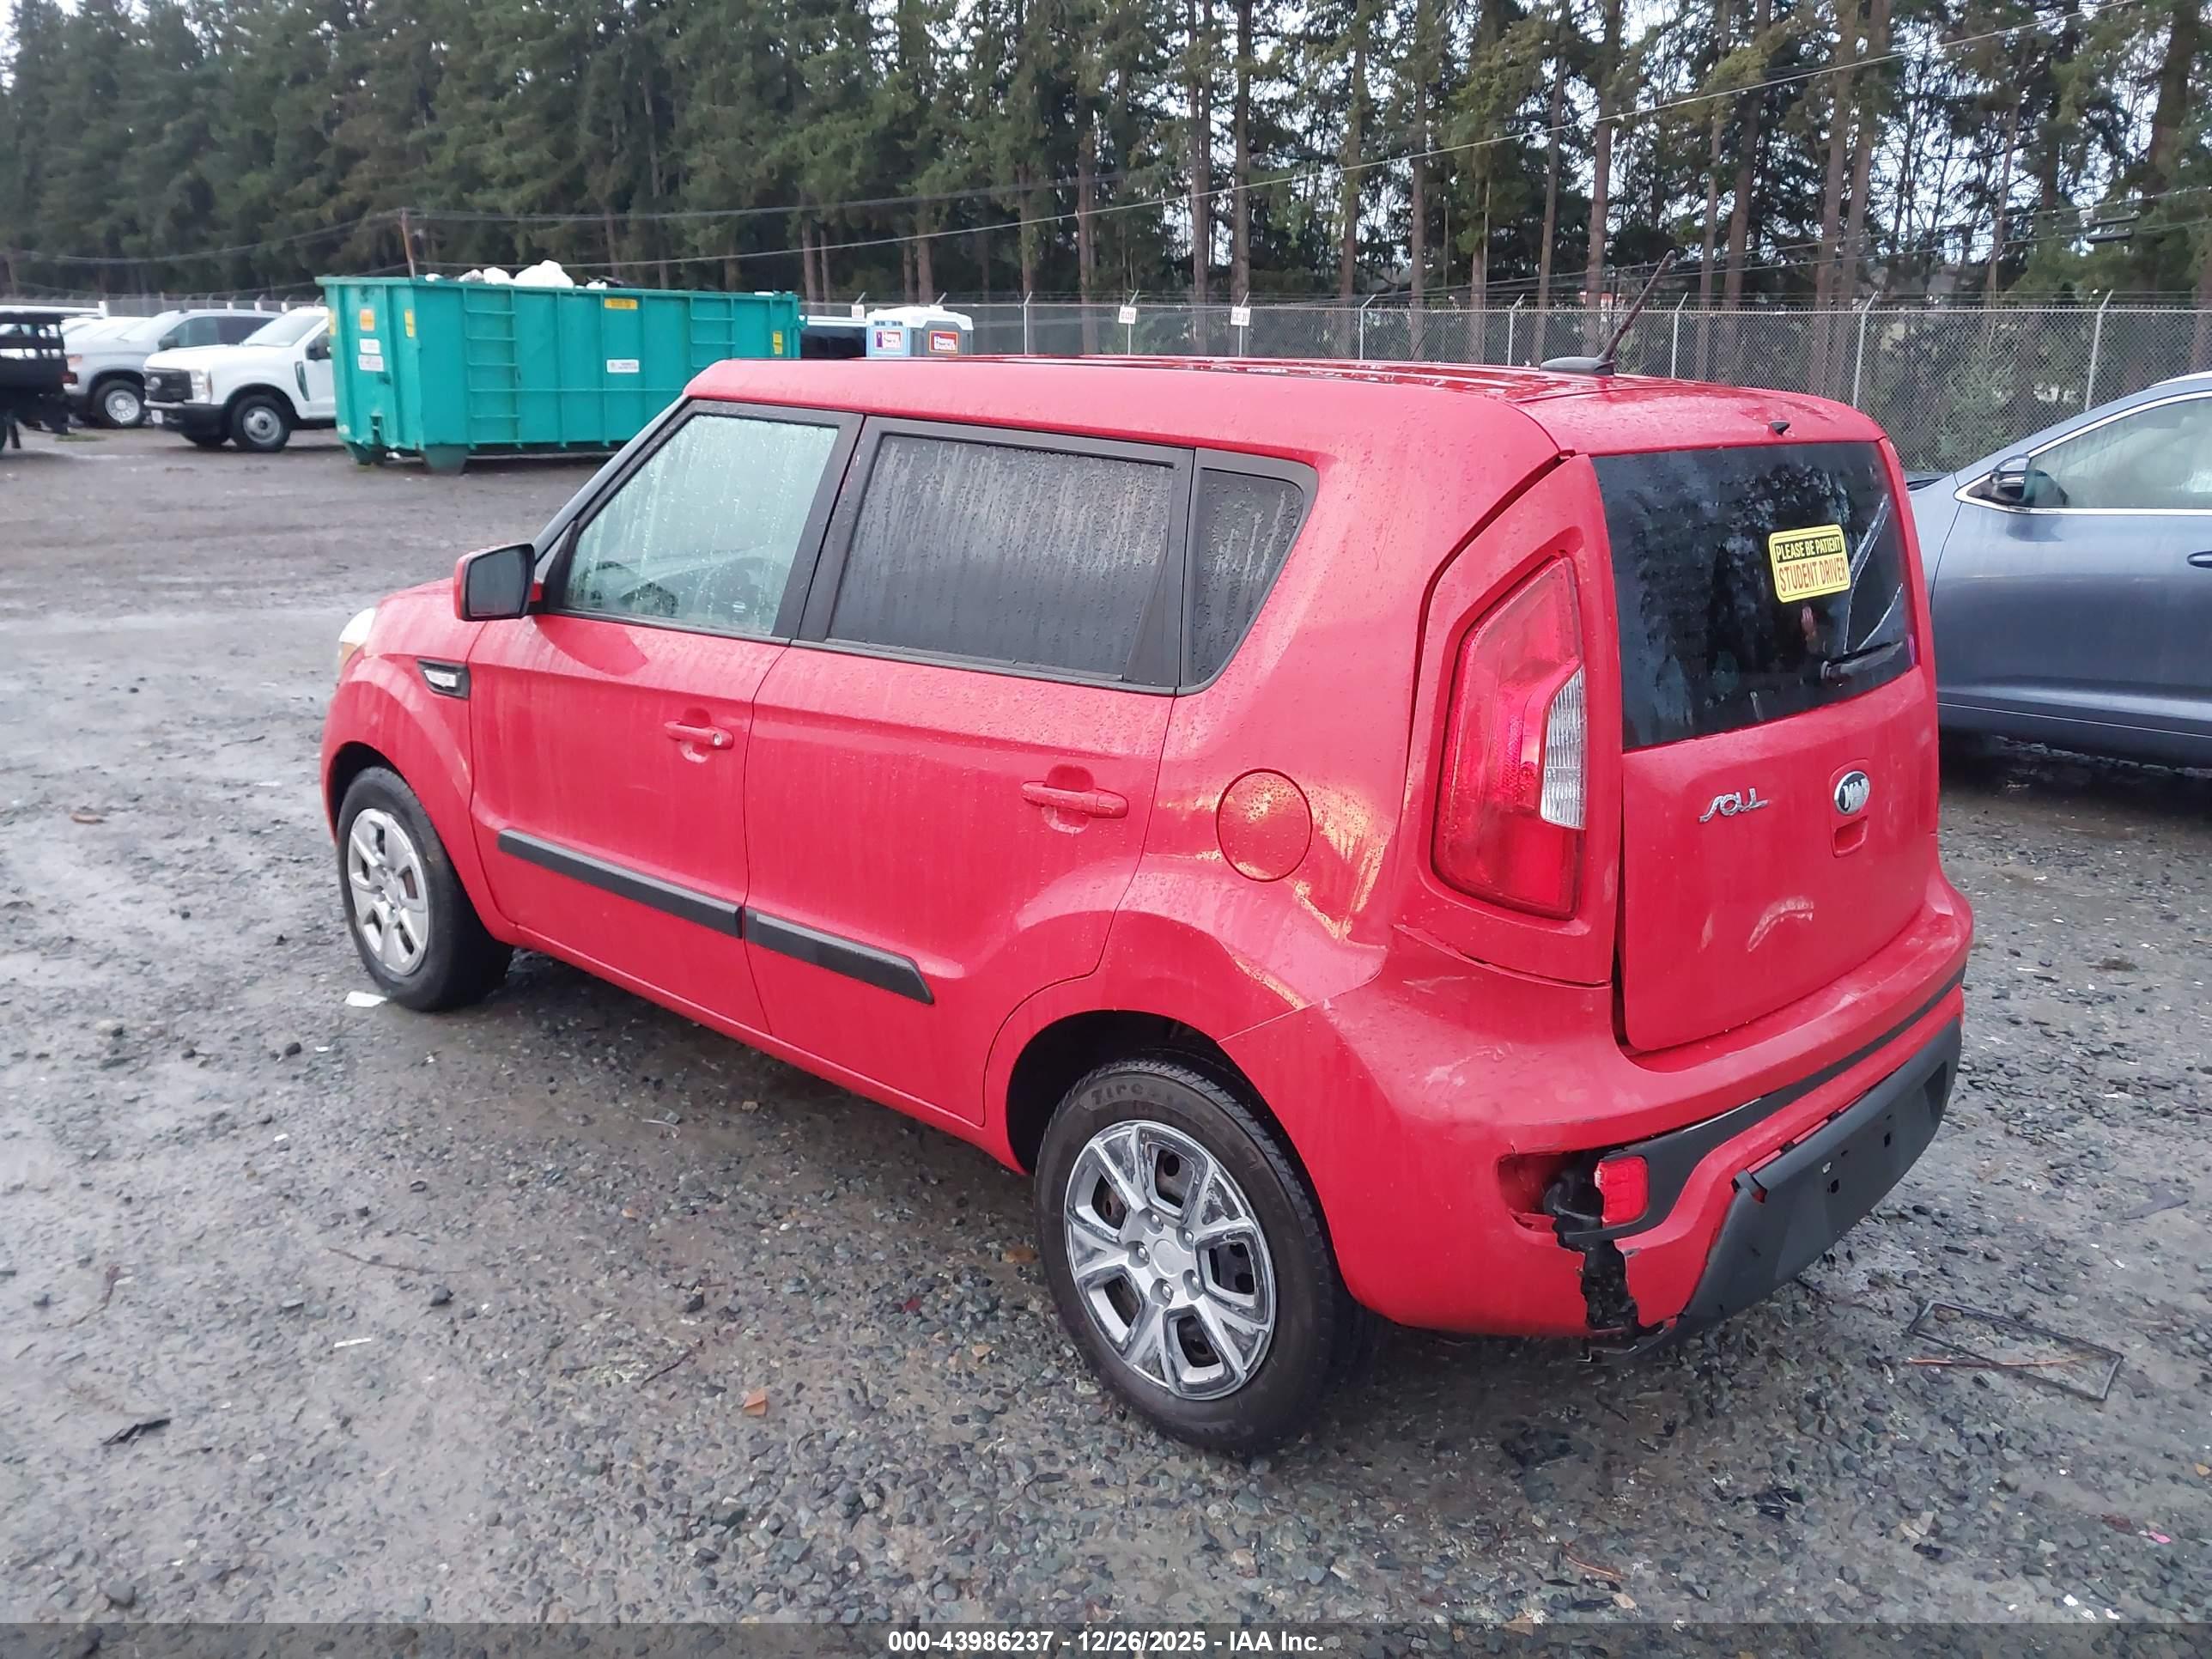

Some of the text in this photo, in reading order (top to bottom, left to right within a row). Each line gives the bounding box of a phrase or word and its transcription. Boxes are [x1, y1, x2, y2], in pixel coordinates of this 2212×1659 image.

[1775, 537, 1841, 561] PLEASE BE PATIENT
[1778, 556, 1847, 592] STUDENT DRIVER
